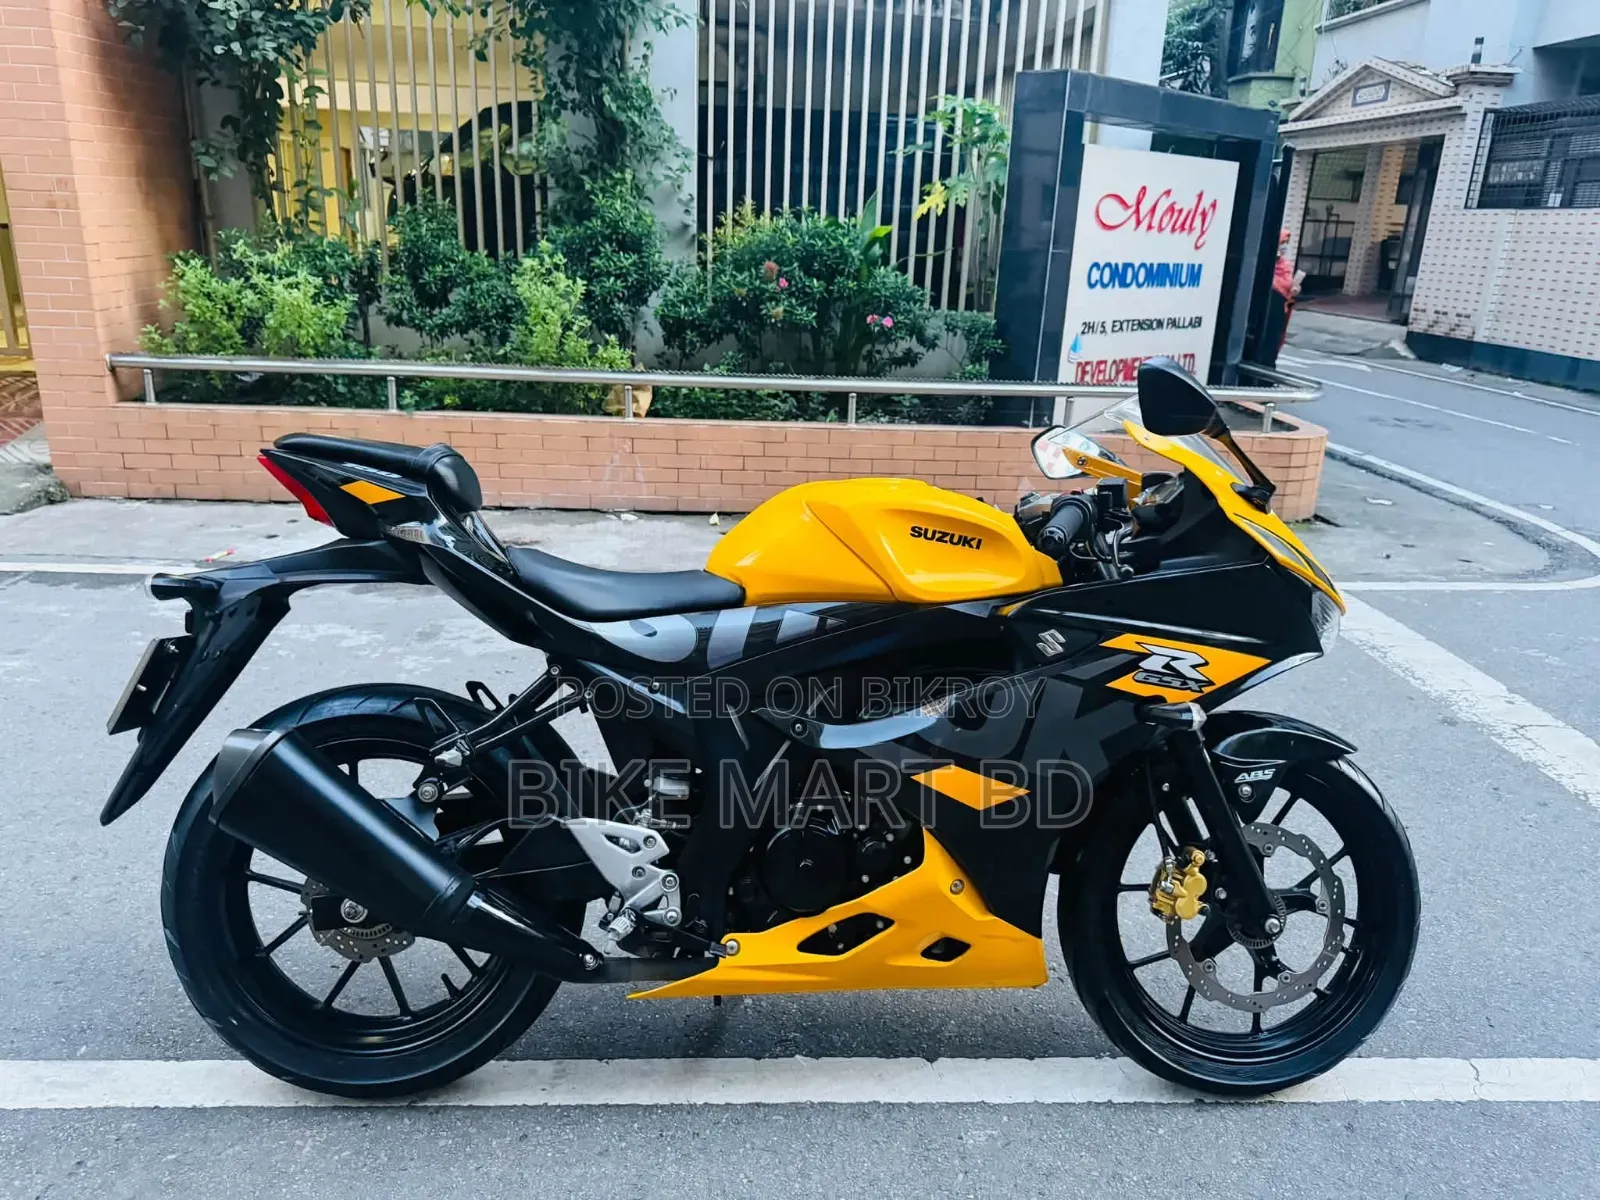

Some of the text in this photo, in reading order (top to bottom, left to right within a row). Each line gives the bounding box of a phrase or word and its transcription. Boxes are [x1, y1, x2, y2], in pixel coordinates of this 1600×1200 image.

[1094, 185, 1218, 250] Mouly
[1087, 261, 1203, 289] CONDOMINIUM
[1111, 319, 1165, 333] EXTENSION
[1166, 316, 1202, 330] PALLABI
[1075, 356, 1152, 385] DEVELOPME
[909, 525, 983, 551] SUZUKI
[1132, 669, 1211, 693] GSX
[1234, 768, 1276, 783] ABS
